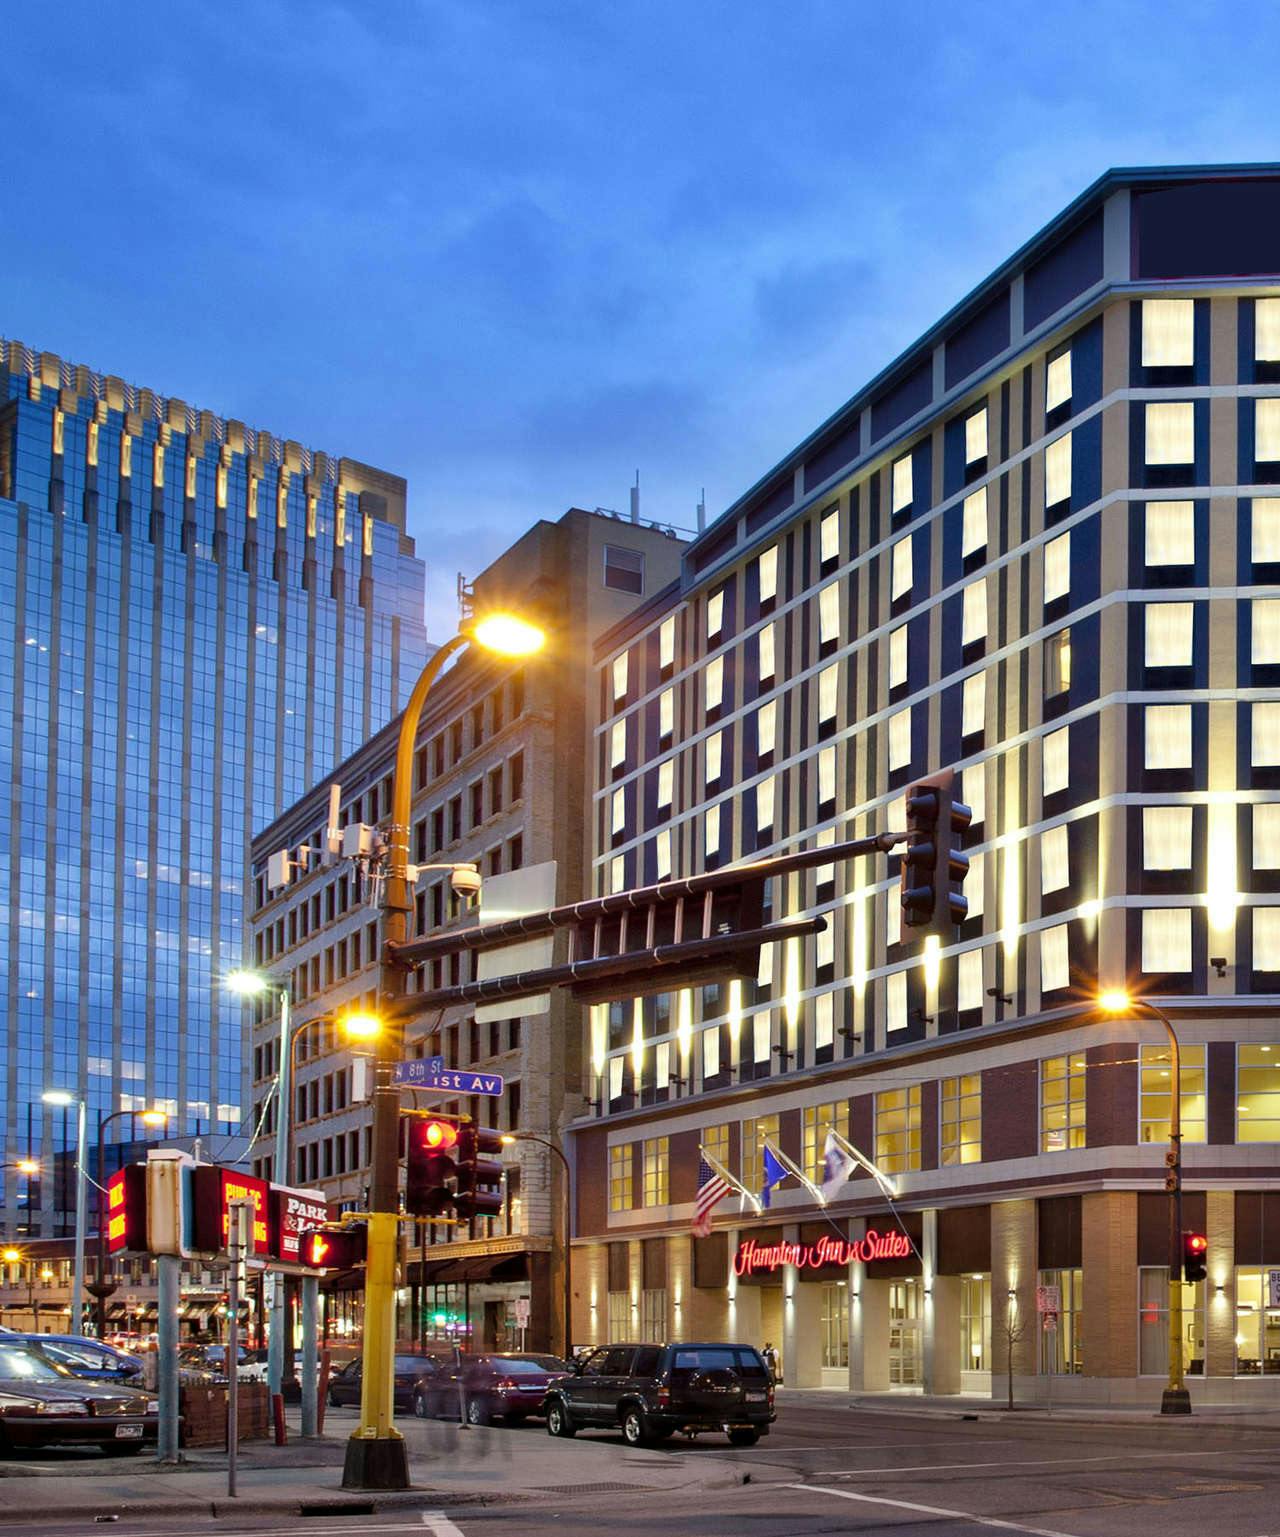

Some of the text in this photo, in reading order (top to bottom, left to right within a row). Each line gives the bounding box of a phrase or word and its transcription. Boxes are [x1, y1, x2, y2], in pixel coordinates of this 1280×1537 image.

[409, 1063, 425, 1077] 8th
[431, 1060, 442, 1074] St
[471, 1077, 496, 1091] Av
[287, 1198, 328, 1222] PARK
[733, 1239, 807, 1277] Hampton
[808, 1235, 851, 1269] Inn
[860, 1230, 910, 1262] Suites
